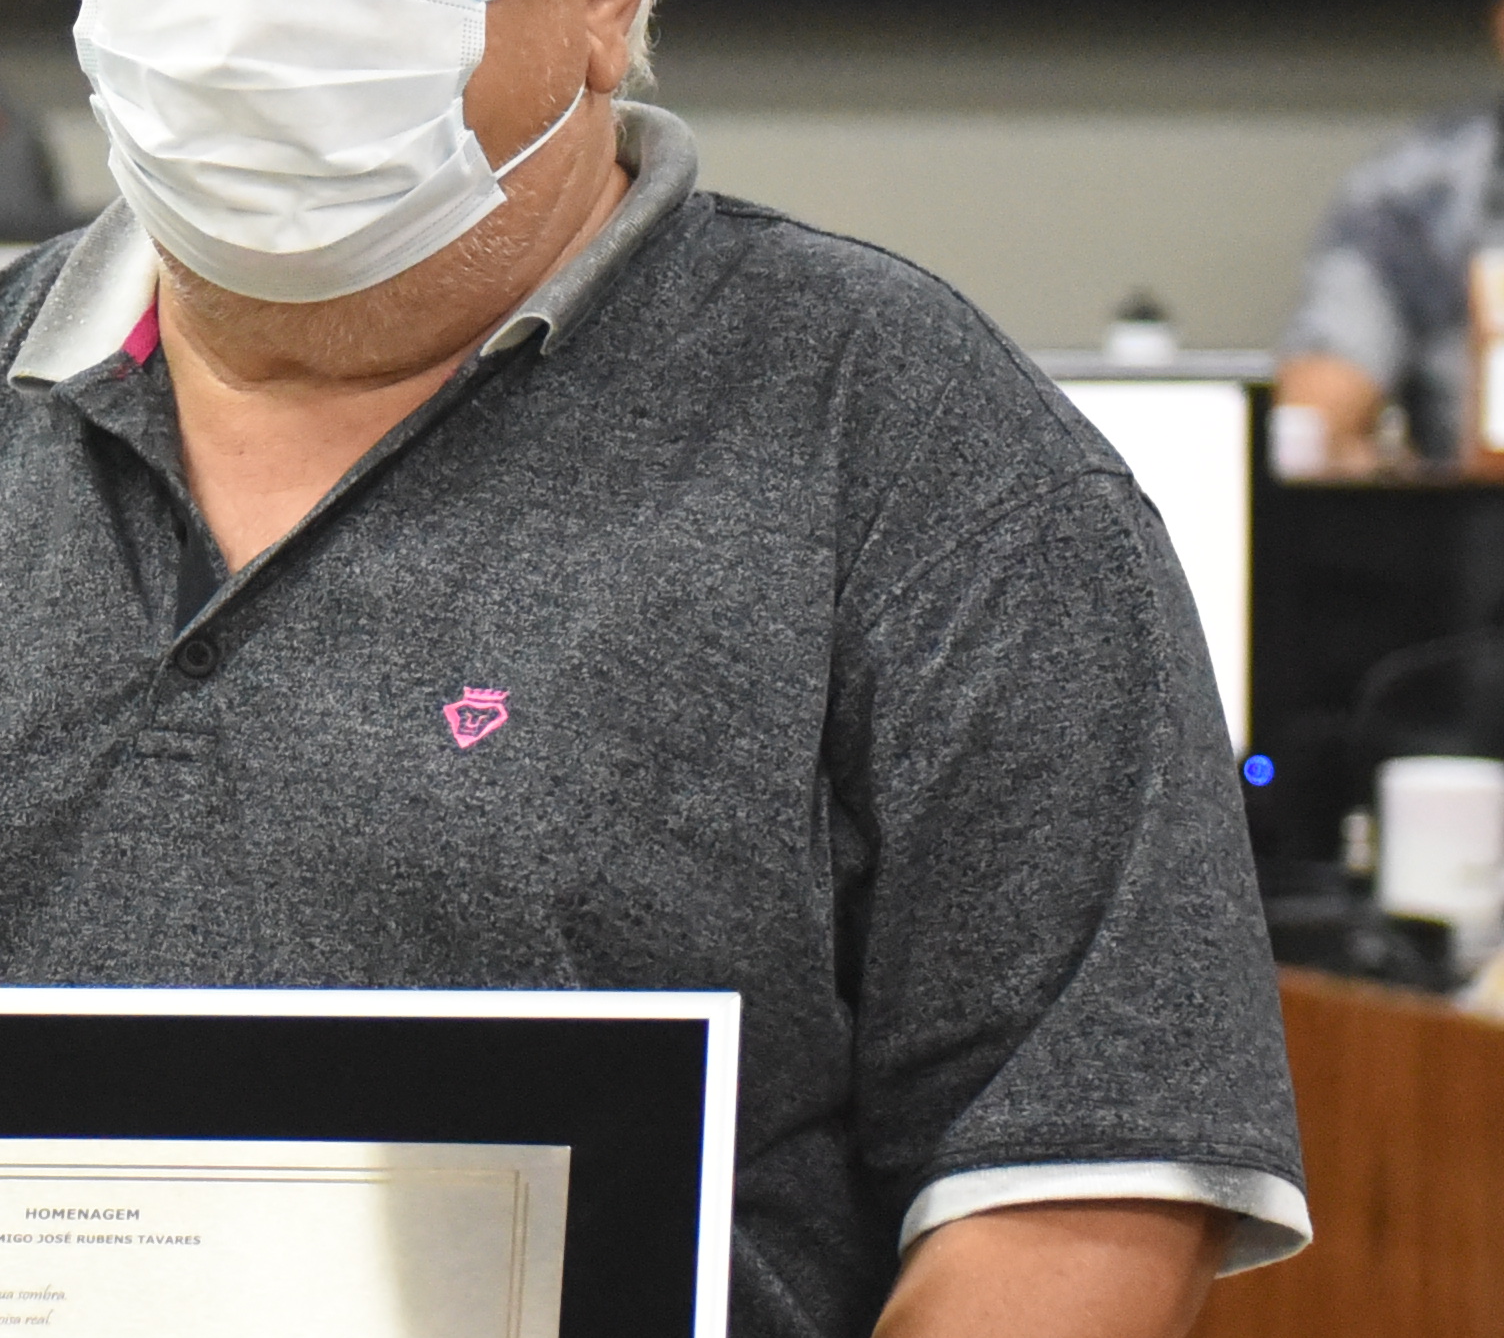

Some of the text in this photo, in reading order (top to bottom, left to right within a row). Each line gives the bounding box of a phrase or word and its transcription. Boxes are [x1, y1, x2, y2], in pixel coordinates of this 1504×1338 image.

[25, 1207, 140, 1221] HOMENAGEM
[36, 1231, 72, 1244] JOSÉ
[76, 1234, 133, 1245] RUBENS
[137, 1234, 201, 1246] TAVARES
